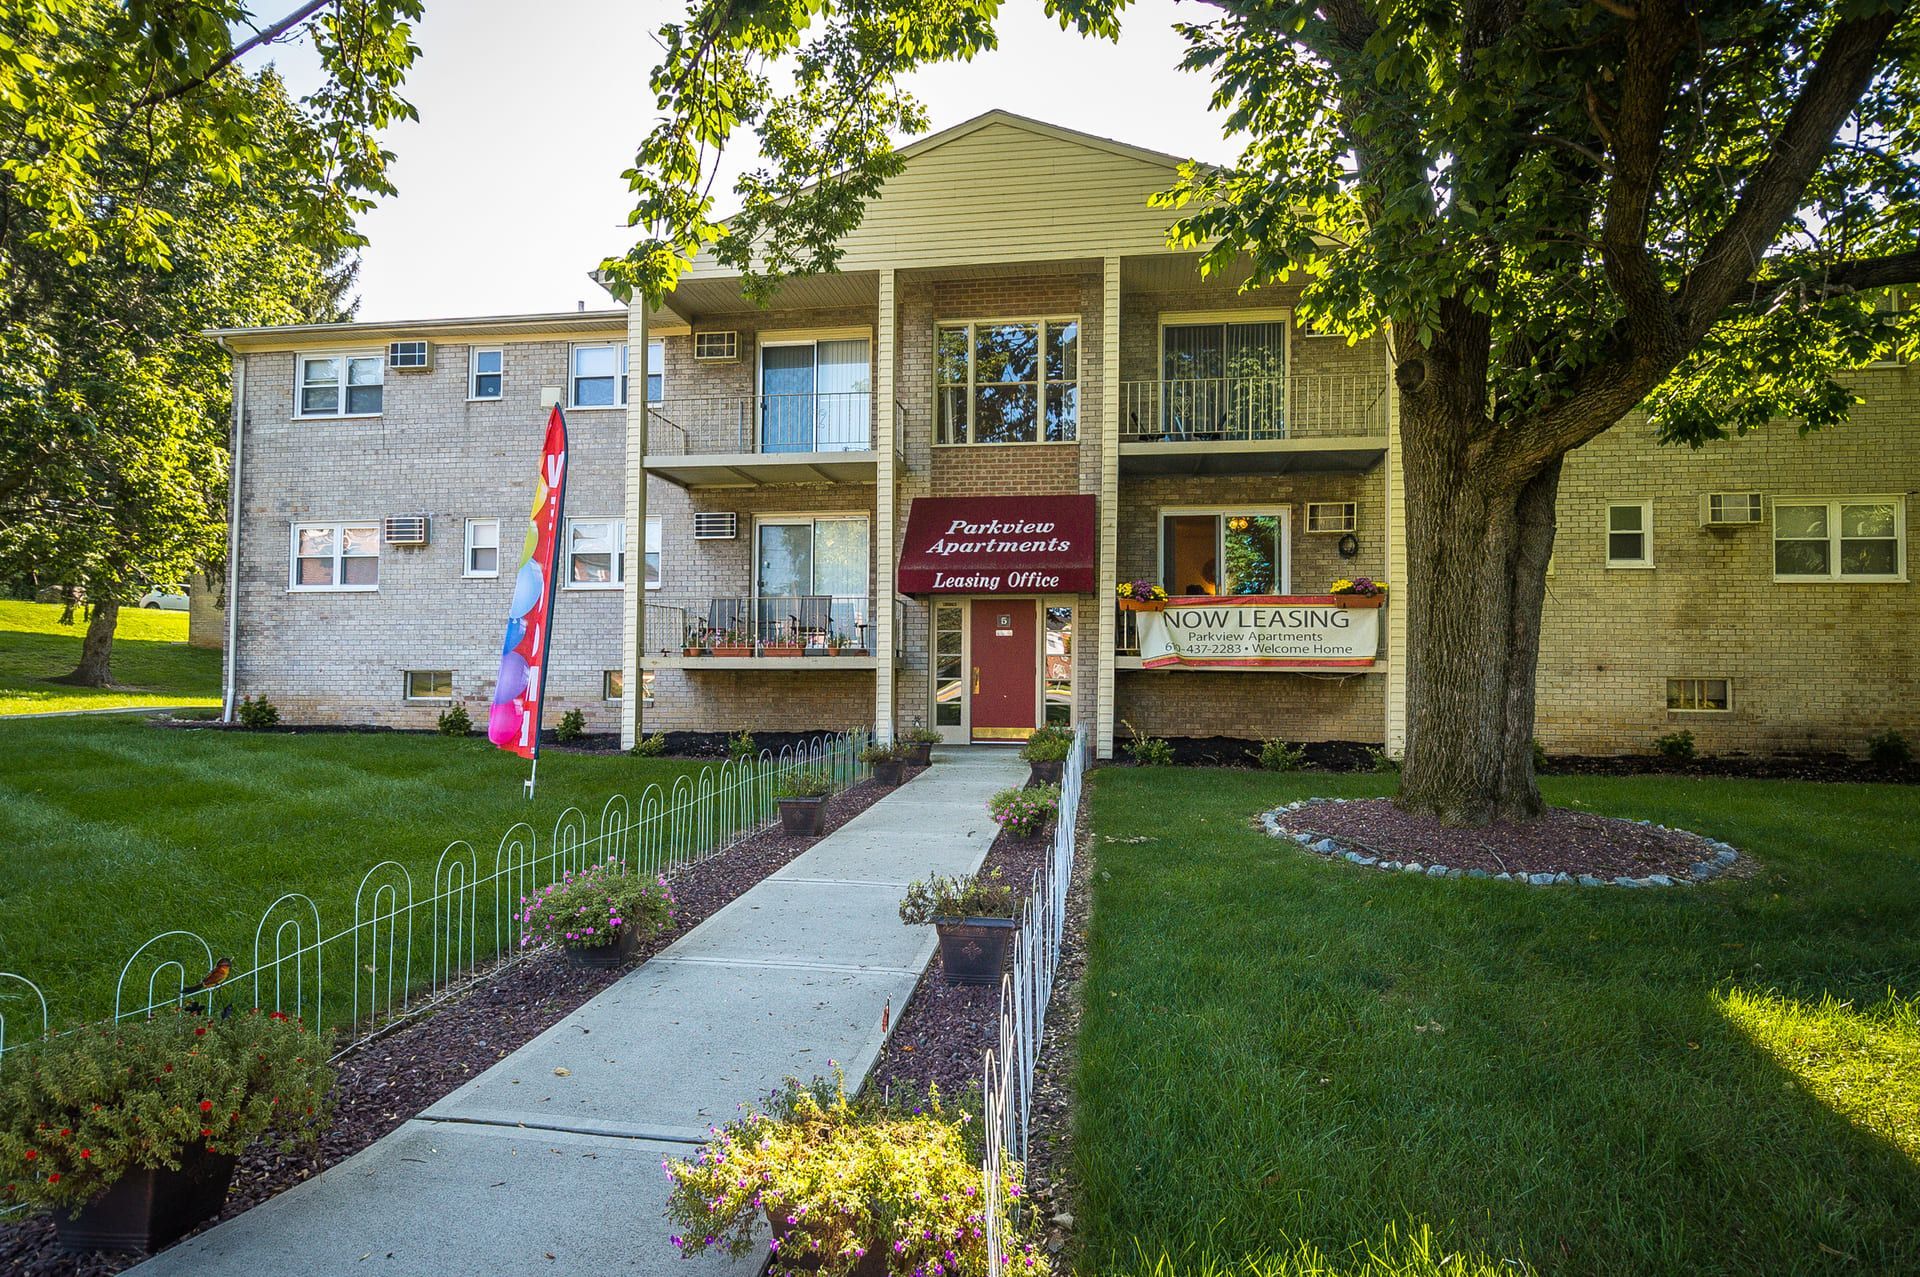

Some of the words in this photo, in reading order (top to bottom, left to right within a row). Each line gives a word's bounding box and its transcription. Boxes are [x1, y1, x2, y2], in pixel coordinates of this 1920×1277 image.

[945, 520, 1055, 534] Parkview
[926, 538, 1070, 555] Apartments
[932, 572, 1000, 590] Leasing
[1008, 571, 1060, 588] Office
[1163, 610, 1229, 628] NOW
[1238, 610, 1349, 628] LEASING
[1188, 631, 1245, 642] Parkview
[1248, 631, 1323, 643] Apartments
[1252, 643, 1309, 654] Welcome
[1314, 644, 1352, 654] Home
